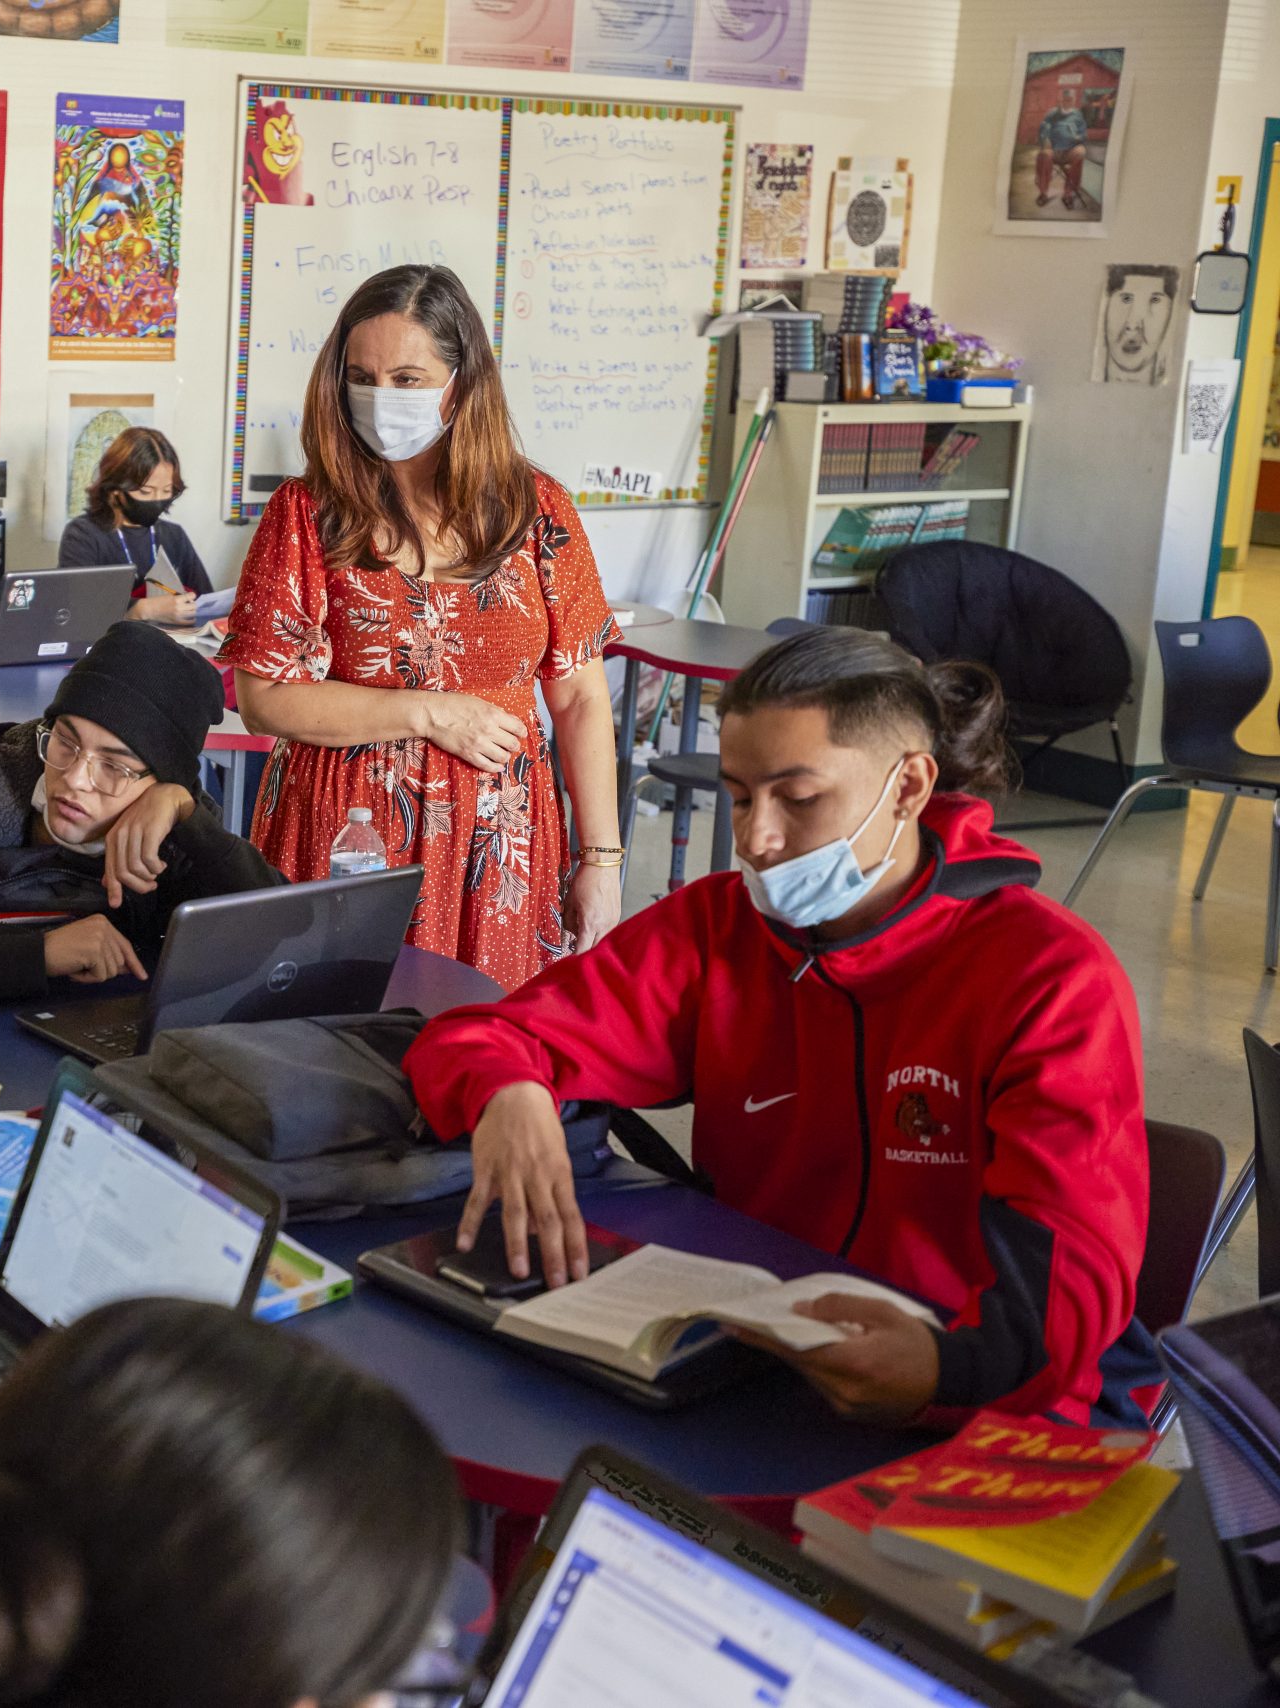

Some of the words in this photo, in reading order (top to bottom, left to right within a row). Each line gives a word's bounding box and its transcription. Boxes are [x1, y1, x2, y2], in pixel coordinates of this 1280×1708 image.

[538, 121, 599, 155] Poetry
[606, 124, 675, 152] Portfolio
[331, 141, 418, 177] English
[425, 141, 461, 167] 7-8
[325, 177, 416, 209] Chicanx
[523, 172, 571, 200] Read
[294, 244, 371, 277] Finish
[585, 466, 655, 496] #NoDAPL
[885, 1065, 960, 1098] NORTH
[885, 1147, 969, 1165] BASKETBALL
